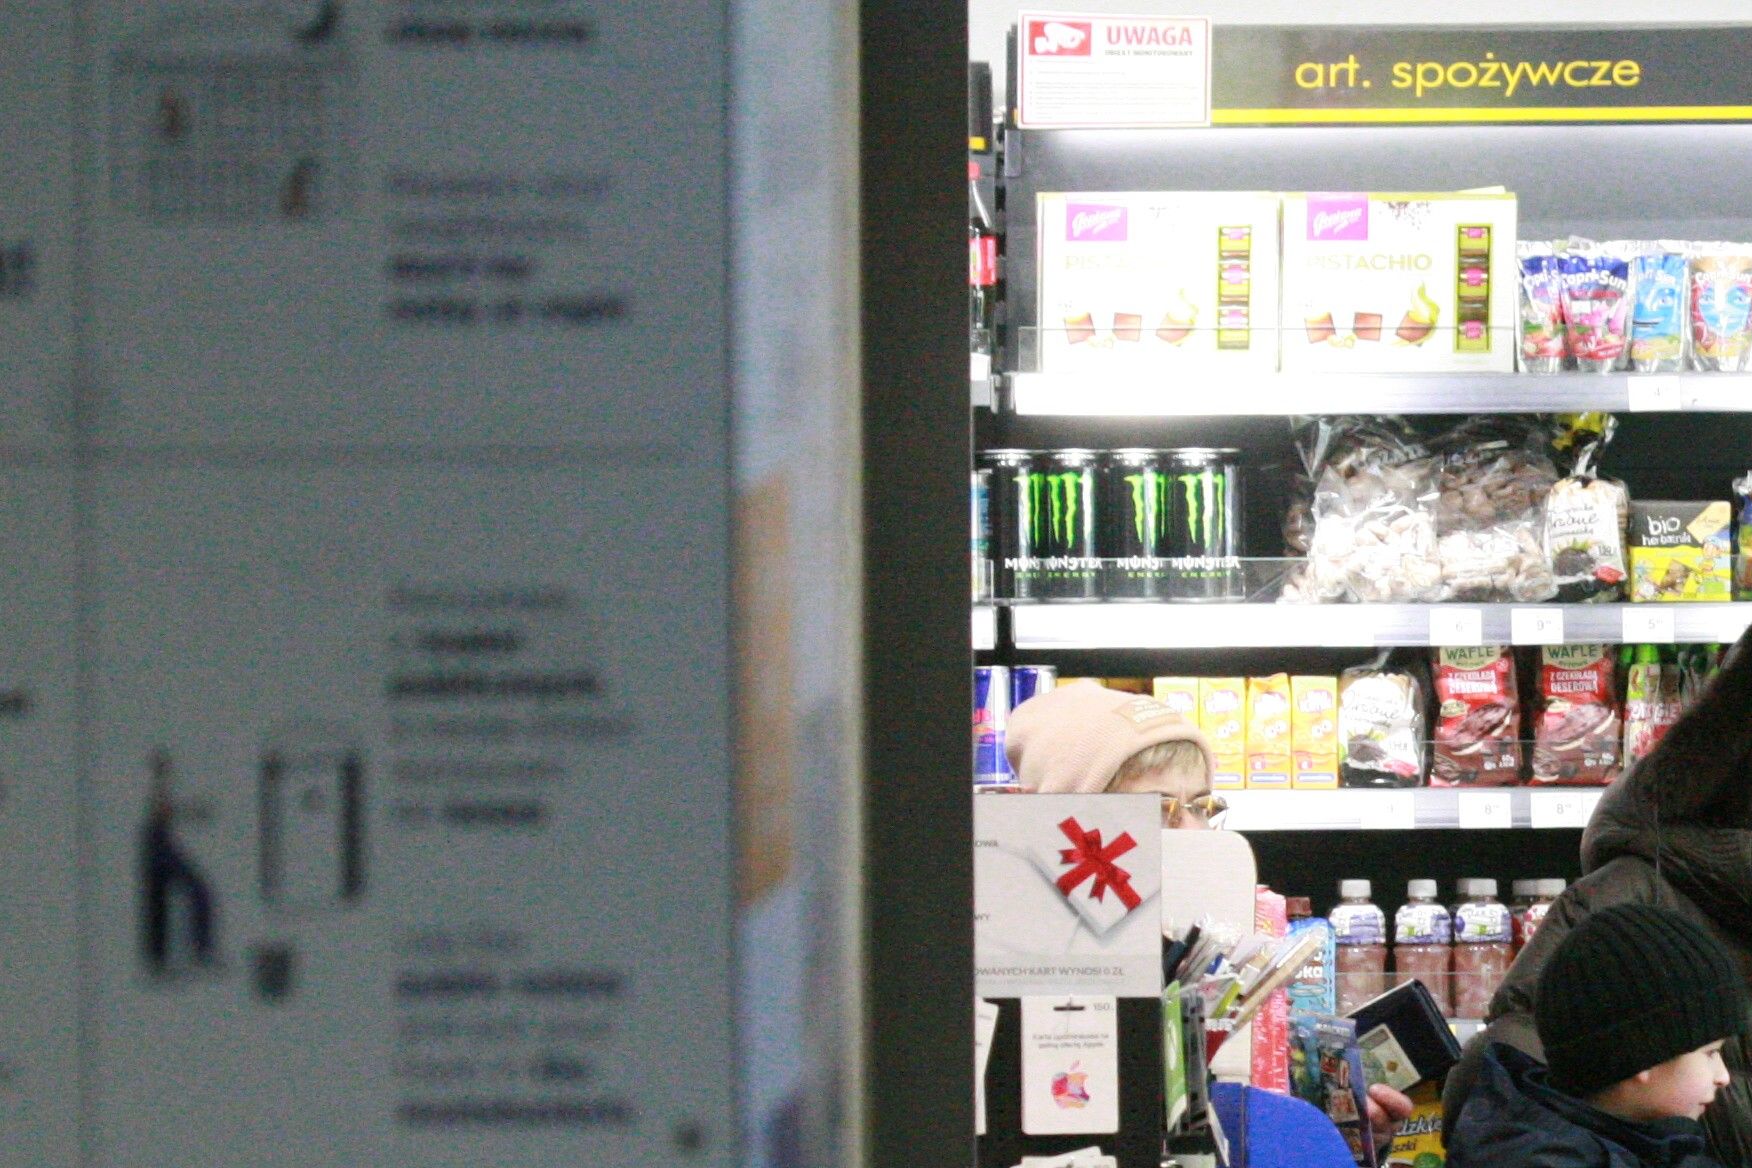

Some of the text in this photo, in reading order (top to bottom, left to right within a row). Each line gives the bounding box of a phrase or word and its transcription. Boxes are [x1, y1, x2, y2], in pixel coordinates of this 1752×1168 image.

[1105, 25, 1194, 46] UWAGA
[1295, 52, 1642, 97] art. spożywcze
[1647, 515, 1681, 536] bio
[1171, 554, 1241, 571] MONSTER
[1445, 646, 1495, 660] WAFLE
[1547, 646, 1597, 659] WAFLE
[1028, 967, 1056, 976] KART
[1058, 967, 1102, 976] WYNOSI
